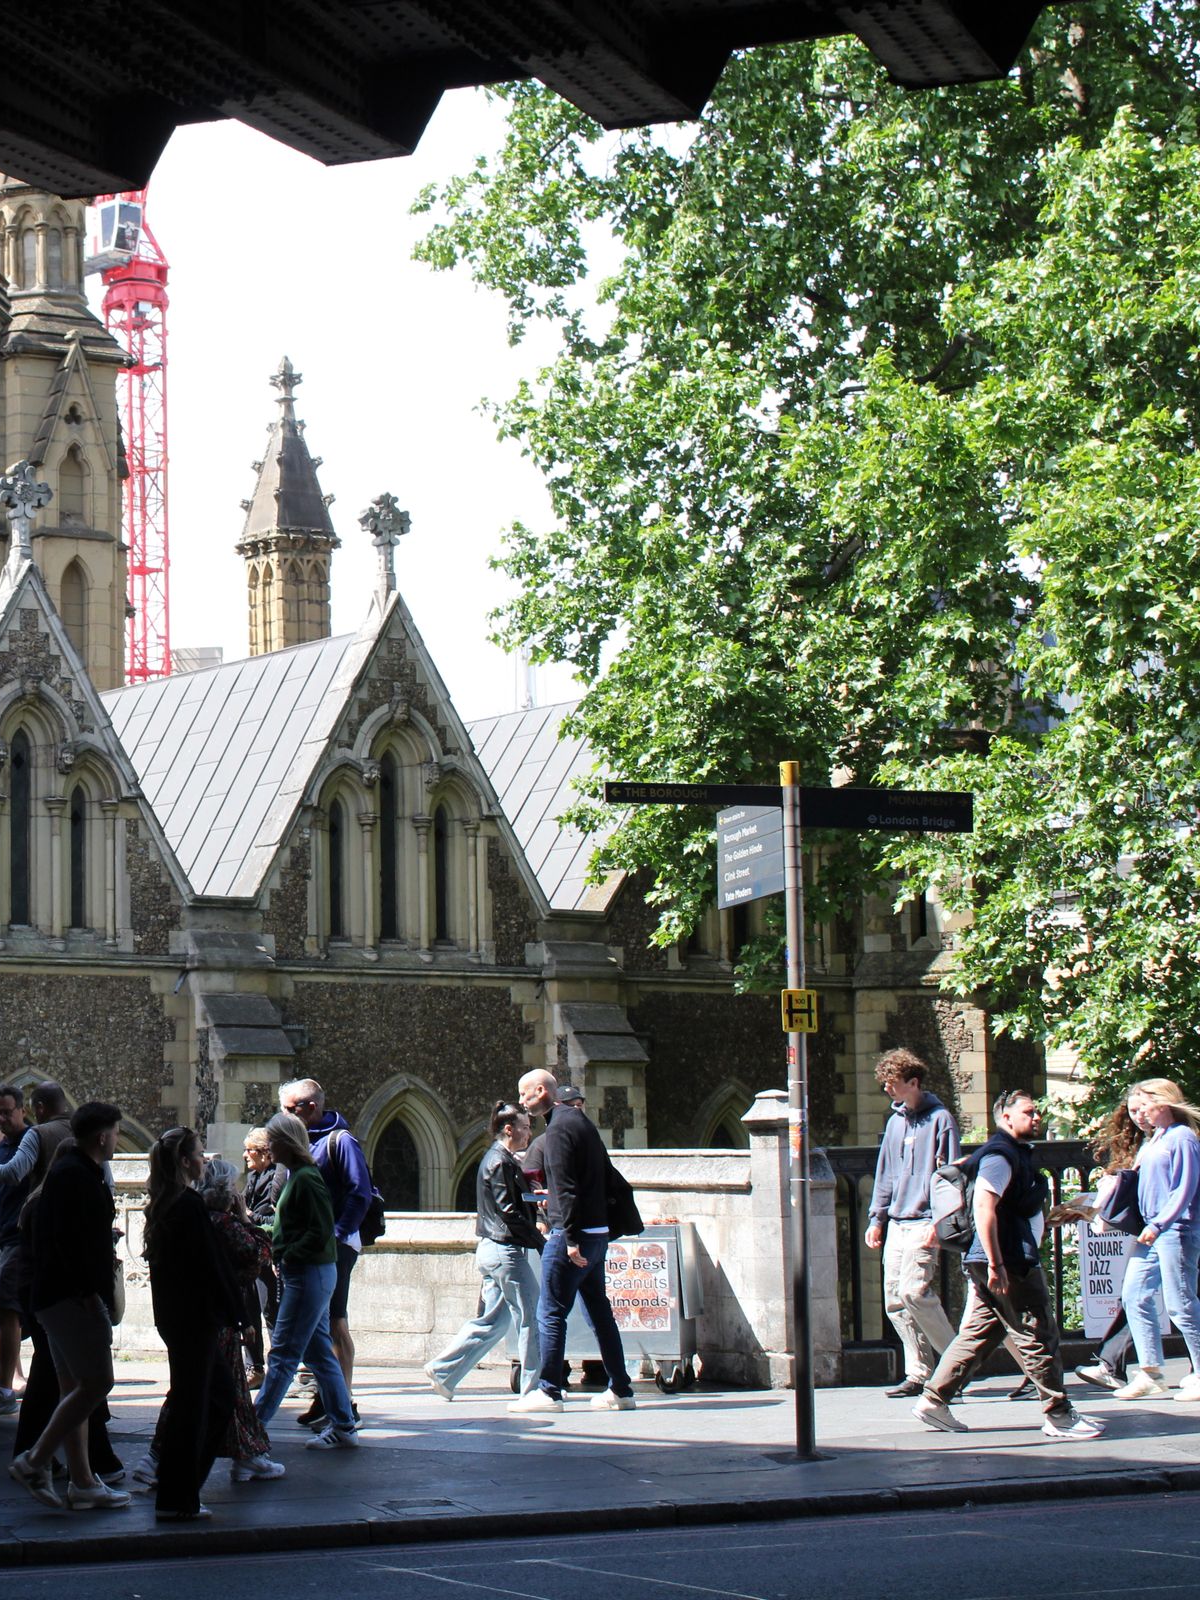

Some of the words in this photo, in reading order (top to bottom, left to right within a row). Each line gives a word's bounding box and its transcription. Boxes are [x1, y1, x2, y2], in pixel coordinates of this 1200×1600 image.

[625, 787, 647, 797] THE
[650, 787, 708, 799] BOROUGH
[888, 794, 953, 807] MONUMENT
[879, 814, 919, 826] London
[922, 815, 956, 828] Bridge
[723, 829, 742, 844] Borough
[741, 824, 758, 839] Market
[724, 852, 733, 863] The
[732, 848, 749, 861] Golden
[724, 870, 736, 882] Clink
[736, 867, 751, 880] Street
[725, 891, 735, 902] Tate
[735, 887, 752, 899] Modern
[1088, 1241, 1124, 1260] SQUARE
[632, 1259, 667, 1271] Best
[1089, 1260, 1111, 1276] JAZZ
[605, 1276, 668, 1289] Peanuts
[1090, 1279, 1113, 1295] DAYS
[610, 1296, 668, 1307] lmonds
